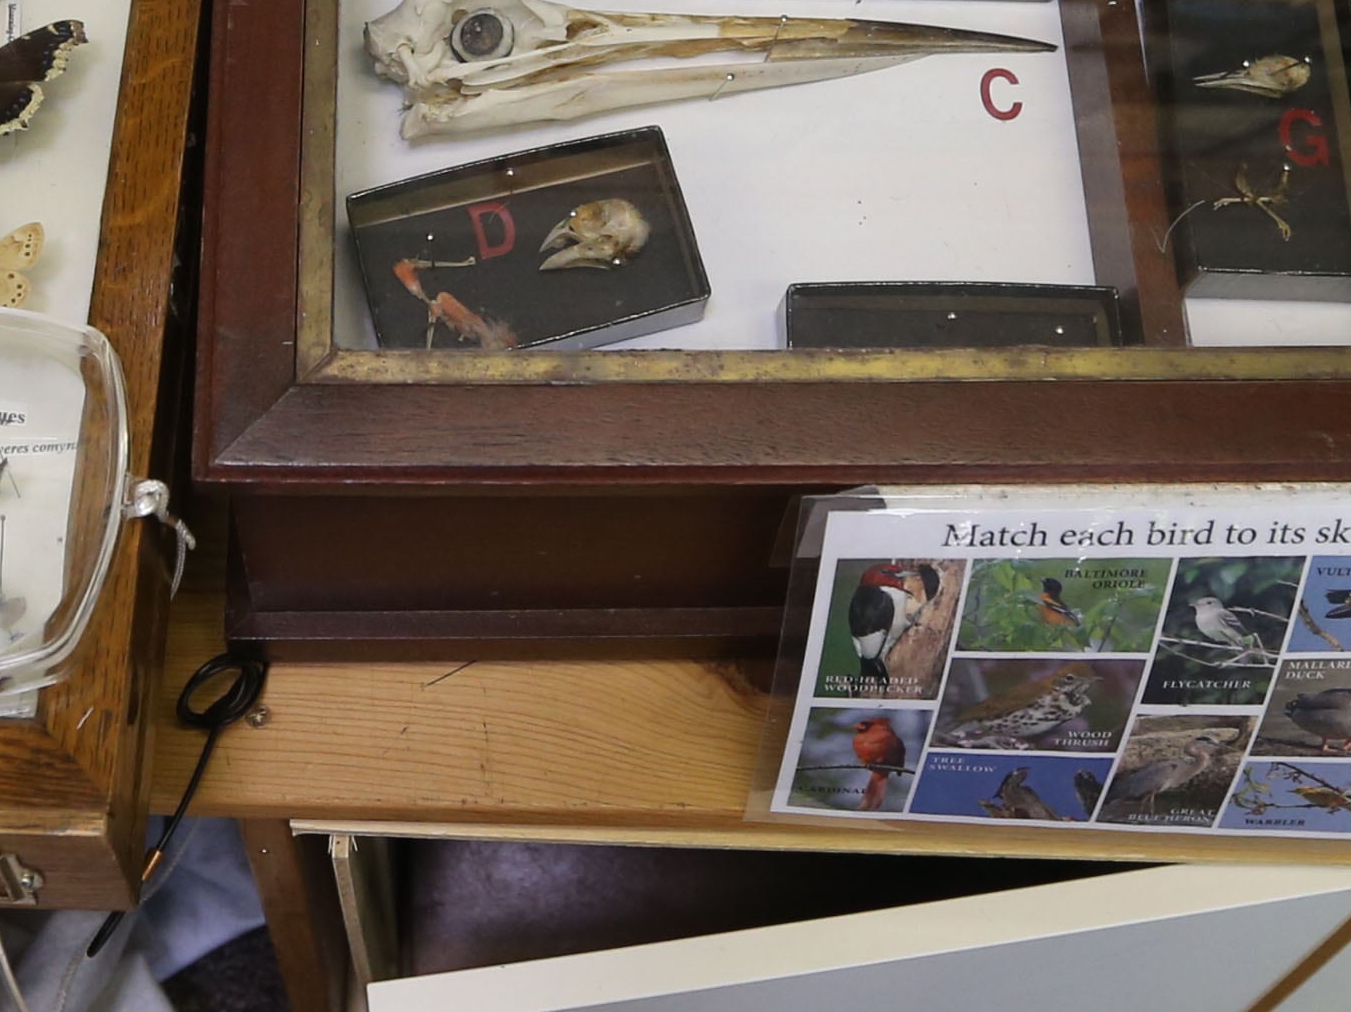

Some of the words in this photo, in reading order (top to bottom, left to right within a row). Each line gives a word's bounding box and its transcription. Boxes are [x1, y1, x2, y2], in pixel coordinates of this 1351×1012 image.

[979, 68, 1023, 121] C
[1278, 108, 1329, 167] G
[467, 202, 516, 260] D
[941, 522, 1048, 548] Match
[1059, 521, 1134, 547] each
[1146, 520, 1215, 546] bird
[1226, 524, 1258, 545] to
[1266, 521, 1306, 544] its
[1064, 568, 1147, 579] BALTIMORE
[1092, 580, 1146, 589] ORIOLE
[1285, 670, 1326, 680] DUCK
[823, 683, 923, 694] WOODPECKER
[1162, 680, 1252, 689] FLYCATCHER
[1067, 731, 1113, 739] WOOD
[1054, 739, 1111, 747] THRUSH
[932, 757, 966, 765] TREE
[929, 764, 998, 773] SWALLOW
[1170, 808, 1216, 817] GREAT
[1244, 819, 1306, 827] WARBLER
